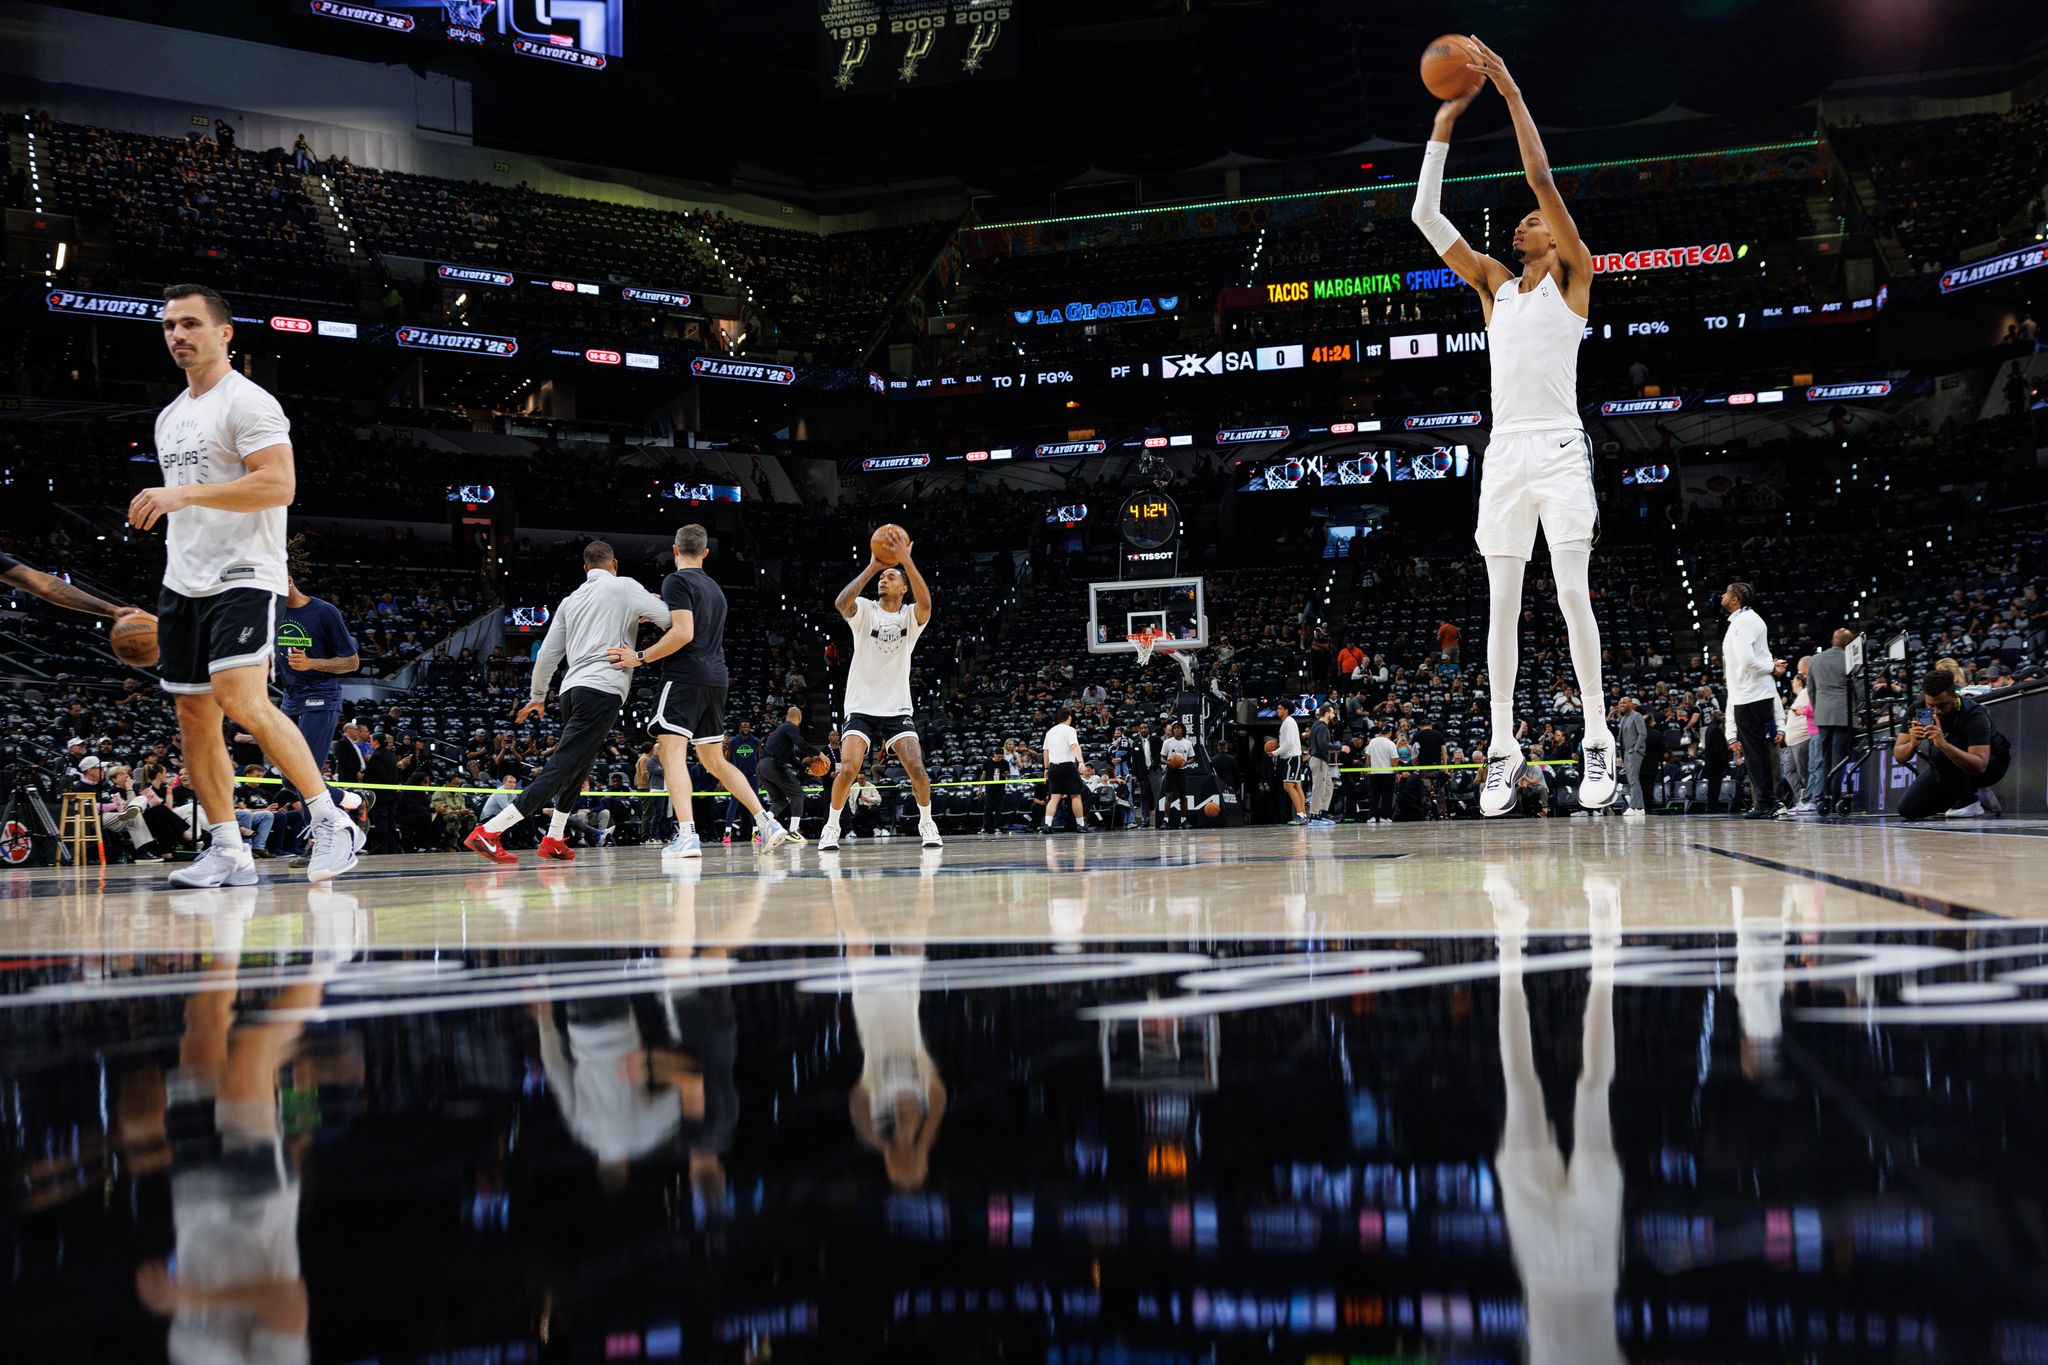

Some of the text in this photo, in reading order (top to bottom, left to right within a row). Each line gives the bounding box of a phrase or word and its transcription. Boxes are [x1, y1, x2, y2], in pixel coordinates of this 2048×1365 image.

[320, 1, 385, 22] PLAYOFFS
[888, 7, 947, 20] CHAMPIONS
[955, 8, 1010, 24] 2005
[825, 14, 880, 28] CHAMPIONS
[891, 16, 946, 33] 2003
[829, 23, 878, 40] 1999
[521, 40, 578, 61] PLAYOFFS
[1592, 243, 1734, 274] URGERTECA
[445, 267, 491, 281] PLAYOFFS
[1949, 250, 2044, 286] PLAYOFFS '26
[1267, 281, 1309, 303] TACOS
[1314, 273, 1401, 299] MARGARITAS
[58, 293, 148, 315] PLAYOFFS
[629, 290, 670, 303] PLAYOFFS
[1036, 298, 1156, 325] LA GLORIA
[1583, 327, 1593, 340] F
[1628, 320, 1670, 336] FG%
[1704, 316, 1728, 329] TO
[1763, 307, 1783, 317] BLK
[1792, 305, 1812, 315] STL
[1822, 302, 1842, 312] AST
[1853, 298, 1872, 309] REB
[408, 330, 508, 354] PLAYOFFS '26
[1226, 332, 1485, 371] SA 0 41:24 1ST 0 MIN
[700, 360, 786, 382] PLAYOFFS '26
[1111, 366, 1130, 379] PF
[890, 380, 907, 389] REB
[916, 379, 932, 387] AST
[941, 377, 957, 385] STL
[966, 375, 982, 383] BLK
[992, 376, 1012, 388] TO
[1038, 371, 1073, 385] FG%
[1813, 386, 1864, 398] PLAYOFFS
[1609, 401, 1657, 413] PLAYOFFS
[1412, 415, 1457, 427] PLAYOFFS
[1223, 428, 1283, 442] PLAYOFFS '26
[1042, 445, 1085, 456] PLAYOFFS
[163, 451, 198, 469] SPURS
[869, 457, 909, 468] PLAYOFFS
[1130, 503, 1167, 518] 41:24
[1140, 552, 1173, 561] TISSOT
[1182, 714, 1193, 724] GET
